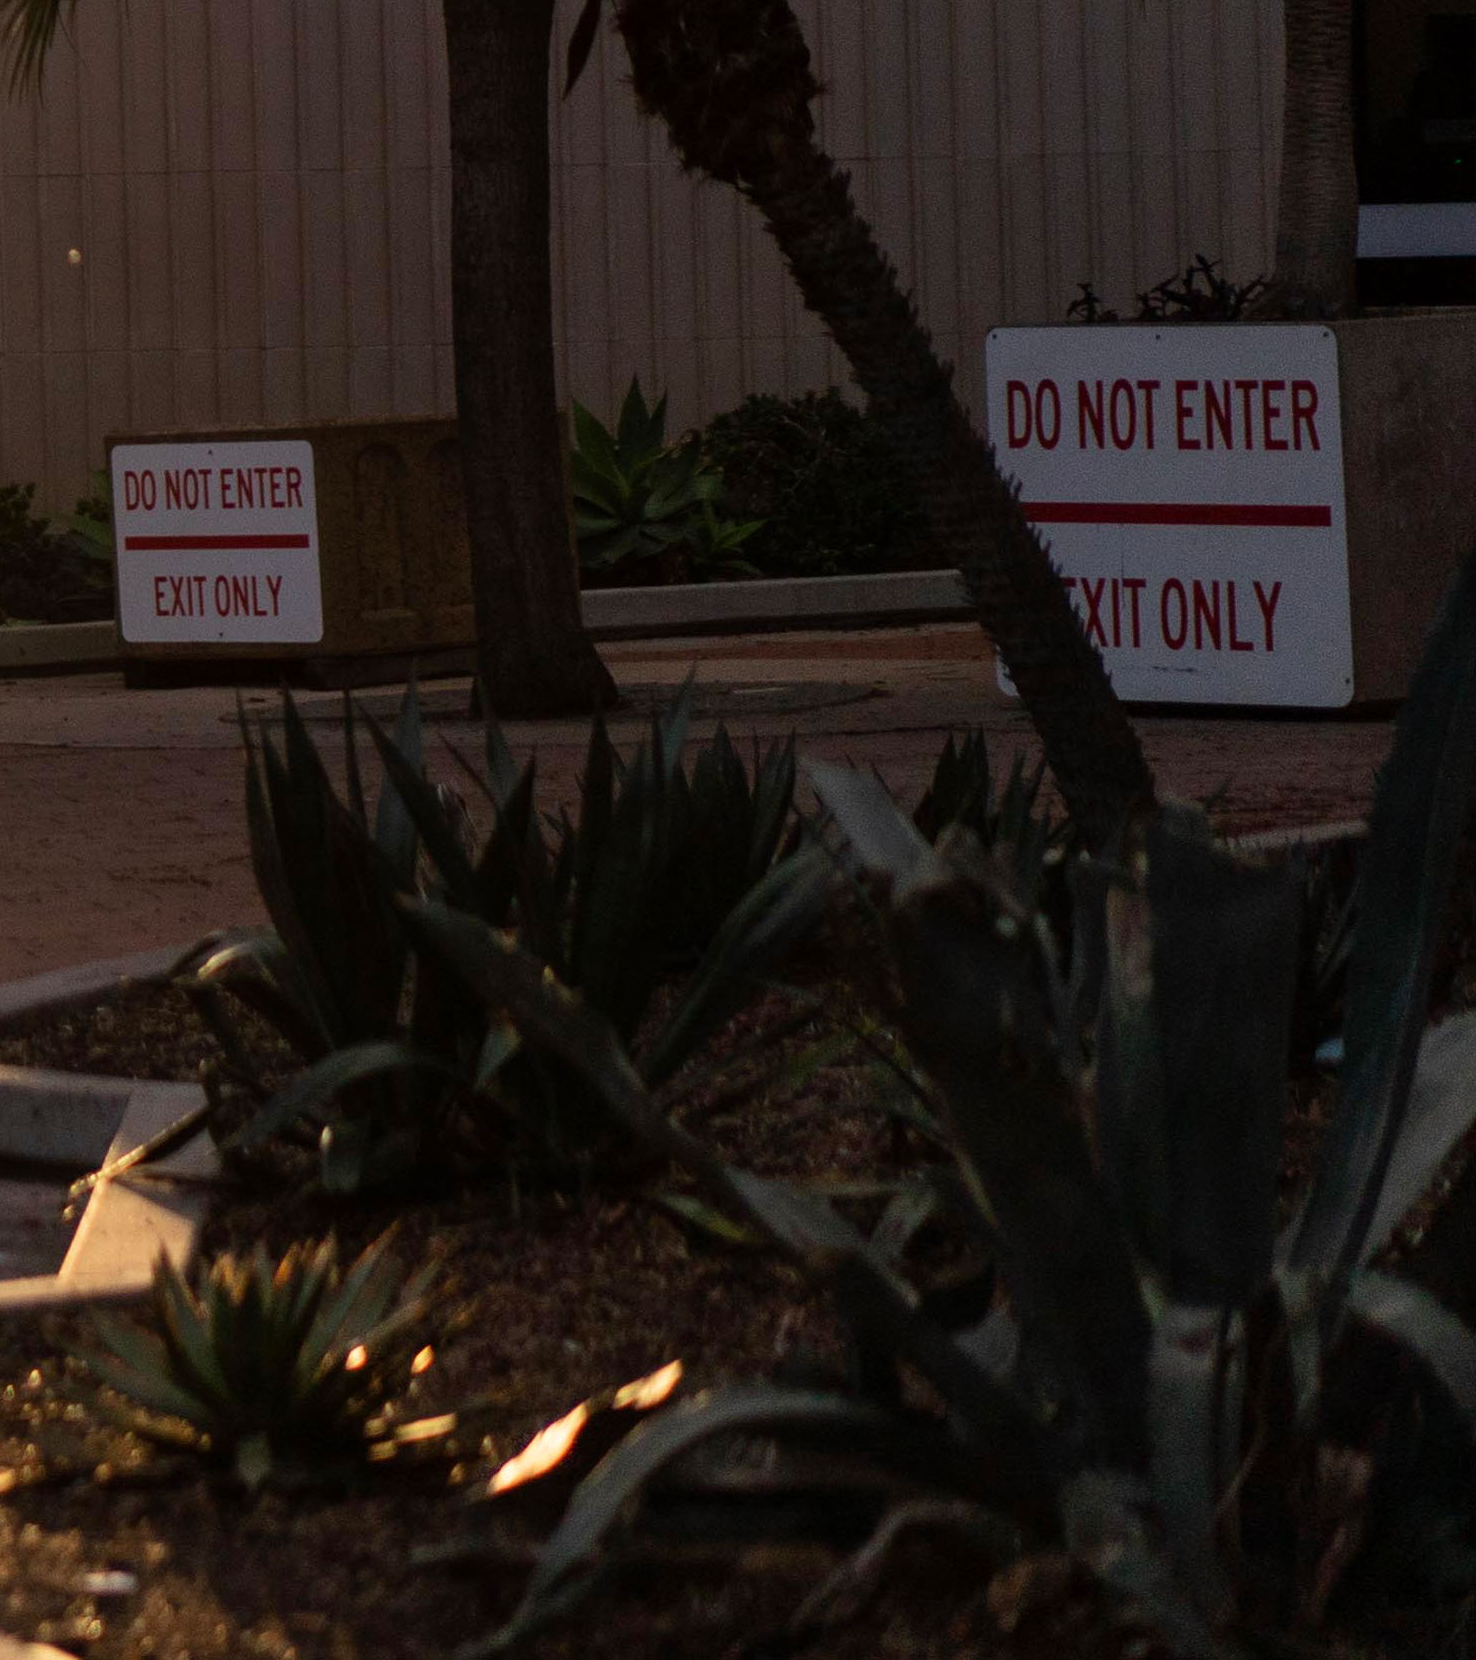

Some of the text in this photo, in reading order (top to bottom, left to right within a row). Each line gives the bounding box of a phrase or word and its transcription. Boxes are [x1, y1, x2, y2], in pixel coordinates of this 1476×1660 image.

[1006, 378, 1321, 451] DO NOT ENTER
[124, 467, 303, 510] DO NOT ENTER
[154, 575, 282, 616] EXIT ONLY
[1062, 577, 1282, 651] XIT ONLY
